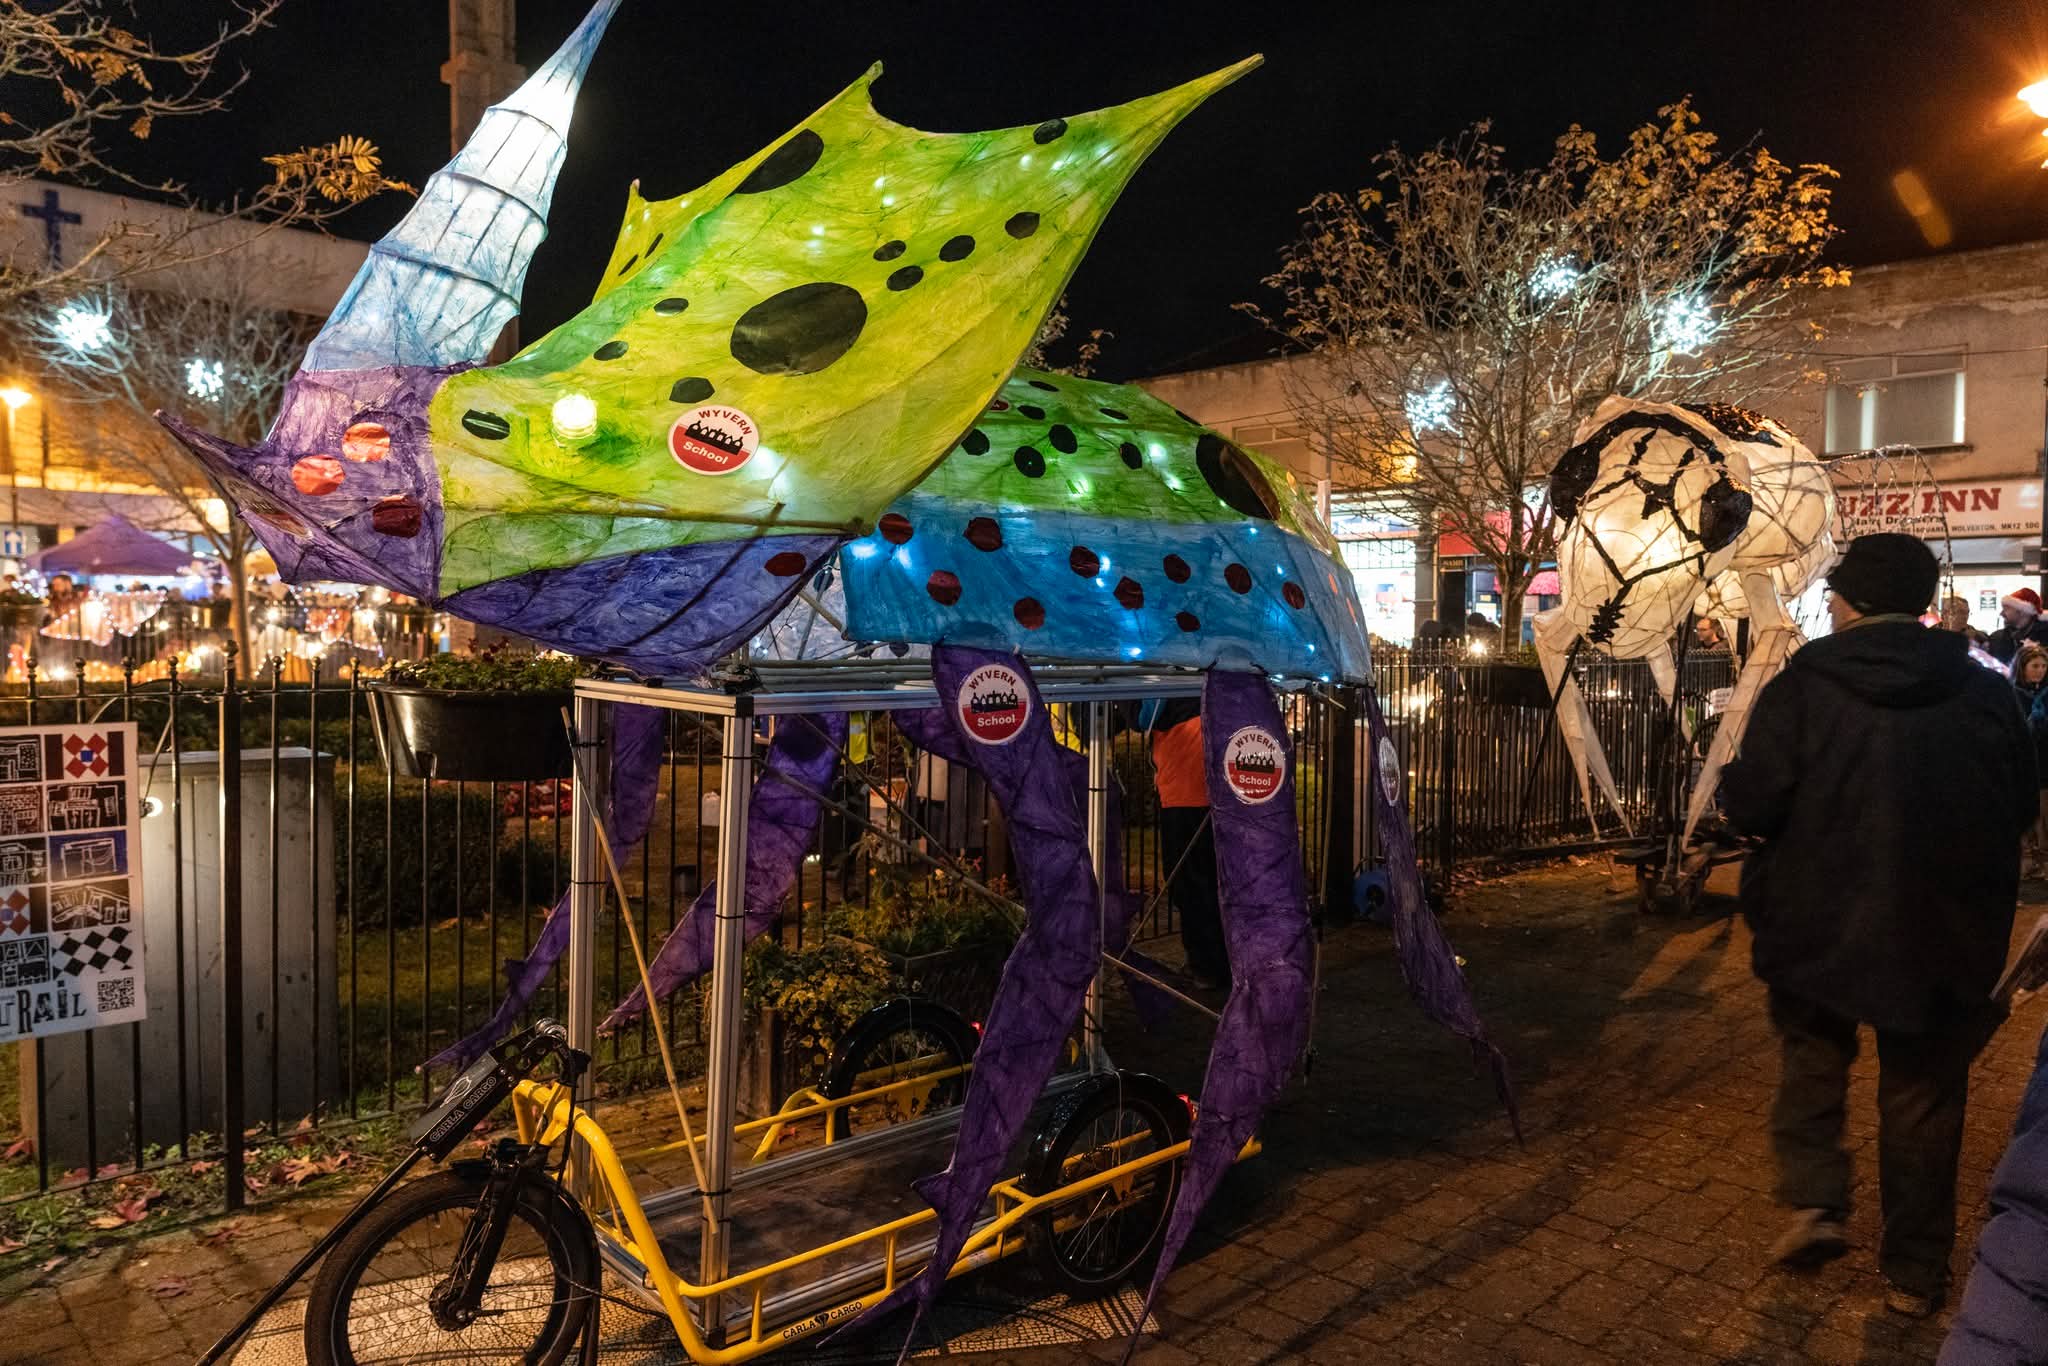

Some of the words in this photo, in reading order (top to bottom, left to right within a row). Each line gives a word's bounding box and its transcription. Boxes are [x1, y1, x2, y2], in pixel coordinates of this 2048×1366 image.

[698, 409, 752, 435] WYVERN
[683, 441, 729, 465] School
[1836, 493, 1910, 518] UZZ
[1922, 487, 2002, 514] INN
[968, 670, 1017, 690] WYVERN
[977, 713, 1016, 727] School
[1235, 733, 1276, 751] WYVERN
[1239, 774, 1272, 786] School
[429, 1109, 465, 1142] CARLA
[462, 1076, 497, 1110] CARGO
[782, 1319, 817, 1339] CARLA
[830, 1301, 863, 1320] CARGO
